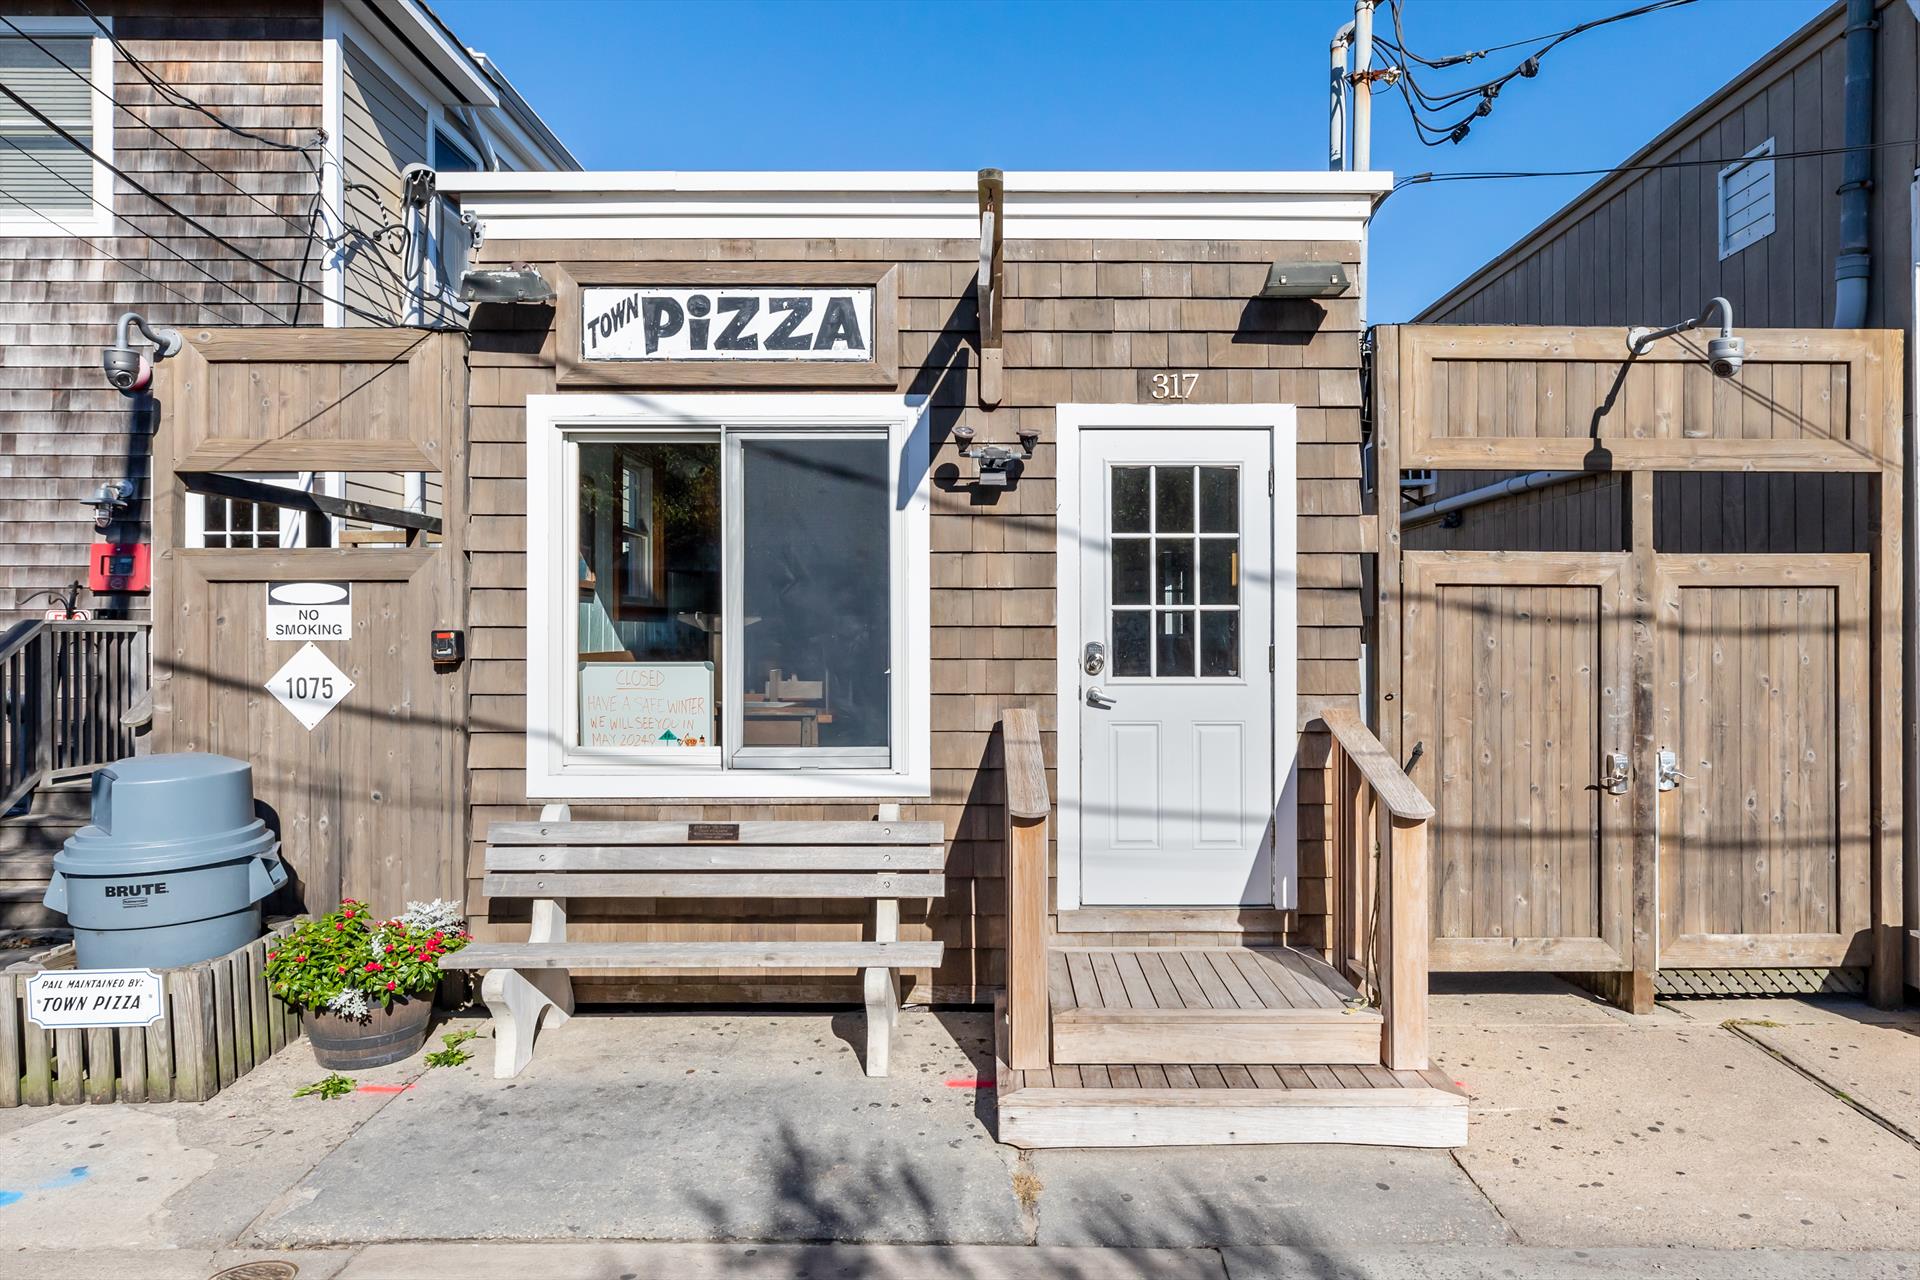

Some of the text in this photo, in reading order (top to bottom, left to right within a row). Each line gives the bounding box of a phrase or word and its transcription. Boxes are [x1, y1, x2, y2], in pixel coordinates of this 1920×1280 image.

[587, 293, 639, 349] TOWN
[1152, 373, 1199, 399] 317
[298, 609, 319, 621] NO
[275, 624, 343, 635] SMOKING
[615, 669, 665, 687] CLOSED
[286, 677, 333, 699] 1075
[587, 695, 705, 716] HAVE A SAFE WINTER
[590, 715, 607, 729] WE
[609, 716, 633, 731] WILL
[682, 718, 695, 732] IN
[592, 732, 617, 747] MAY
[105, 882, 167, 898] BRUTE
[42, 978, 145, 989] PAIL MAINTAINED BY:
[42, 995, 141, 1012] TOWN PIZZA
